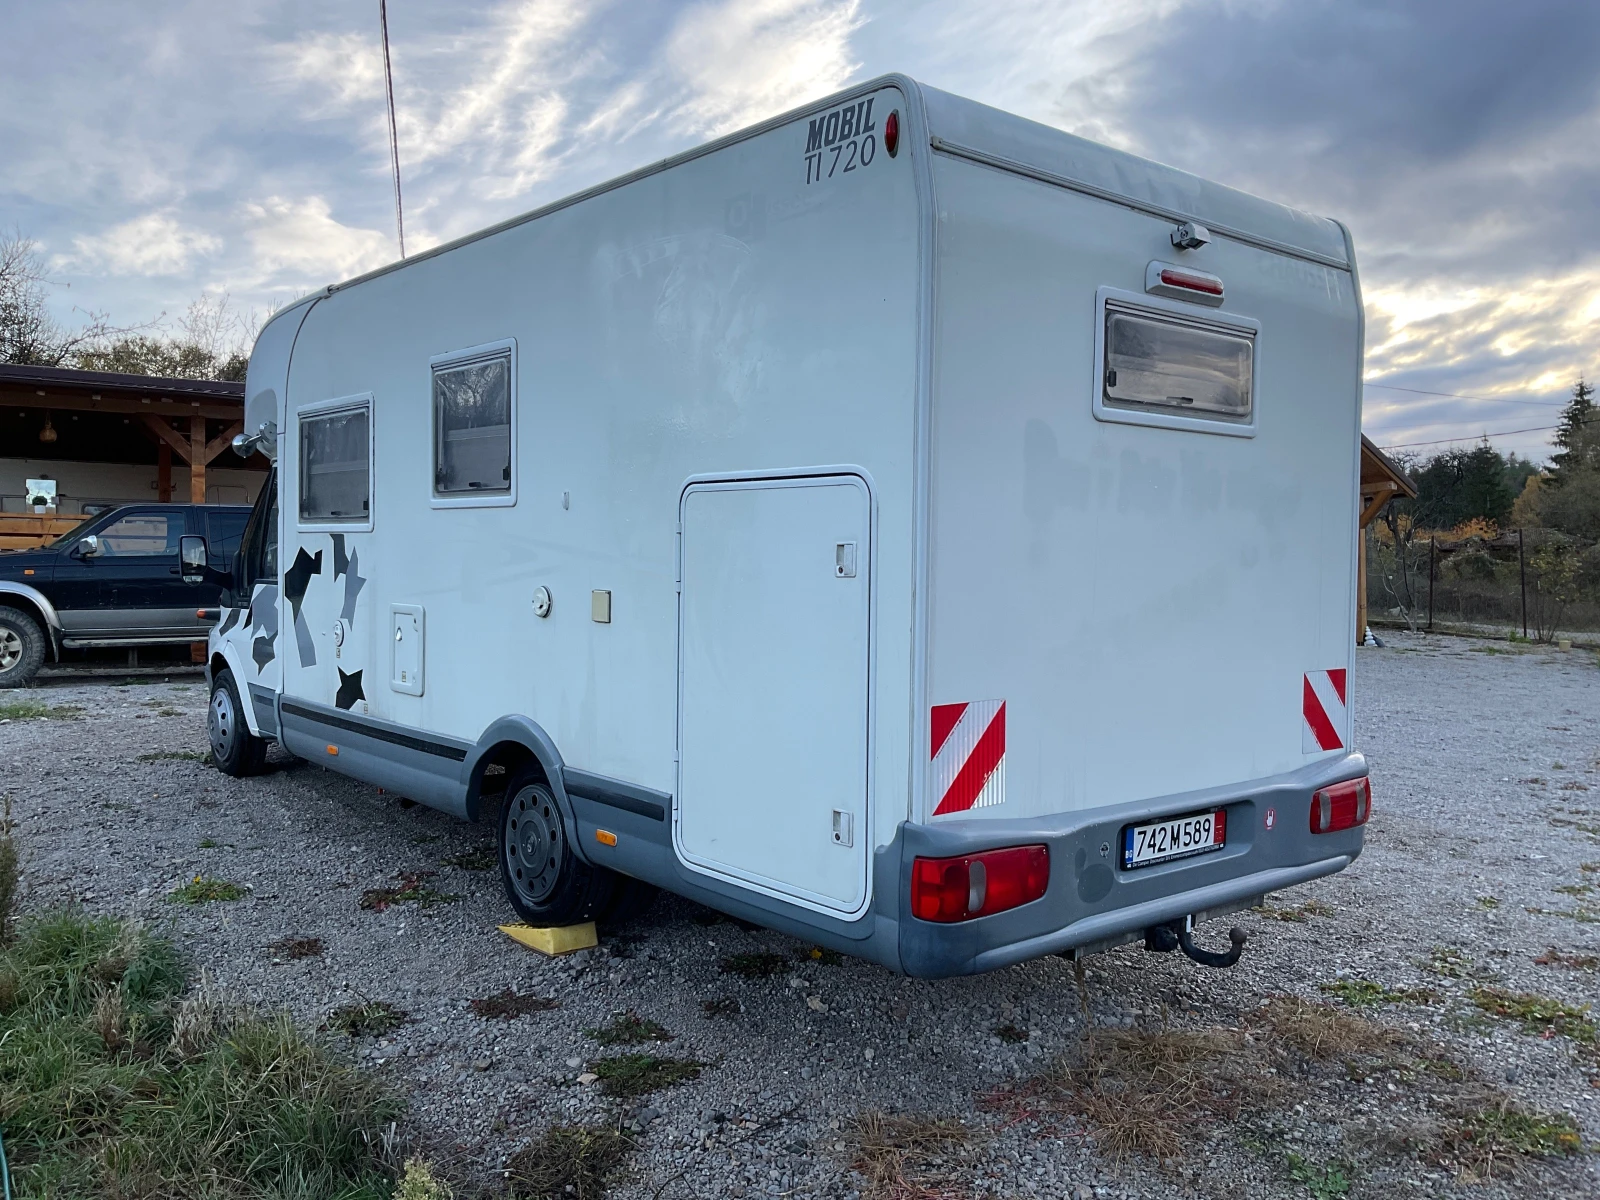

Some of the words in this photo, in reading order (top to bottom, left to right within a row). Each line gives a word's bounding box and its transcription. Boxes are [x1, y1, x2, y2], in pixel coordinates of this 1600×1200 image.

[804, 97, 876, 154] MOBIL
[804, 151, 822, 184] TI
[827, 134, 876, 178] 720
